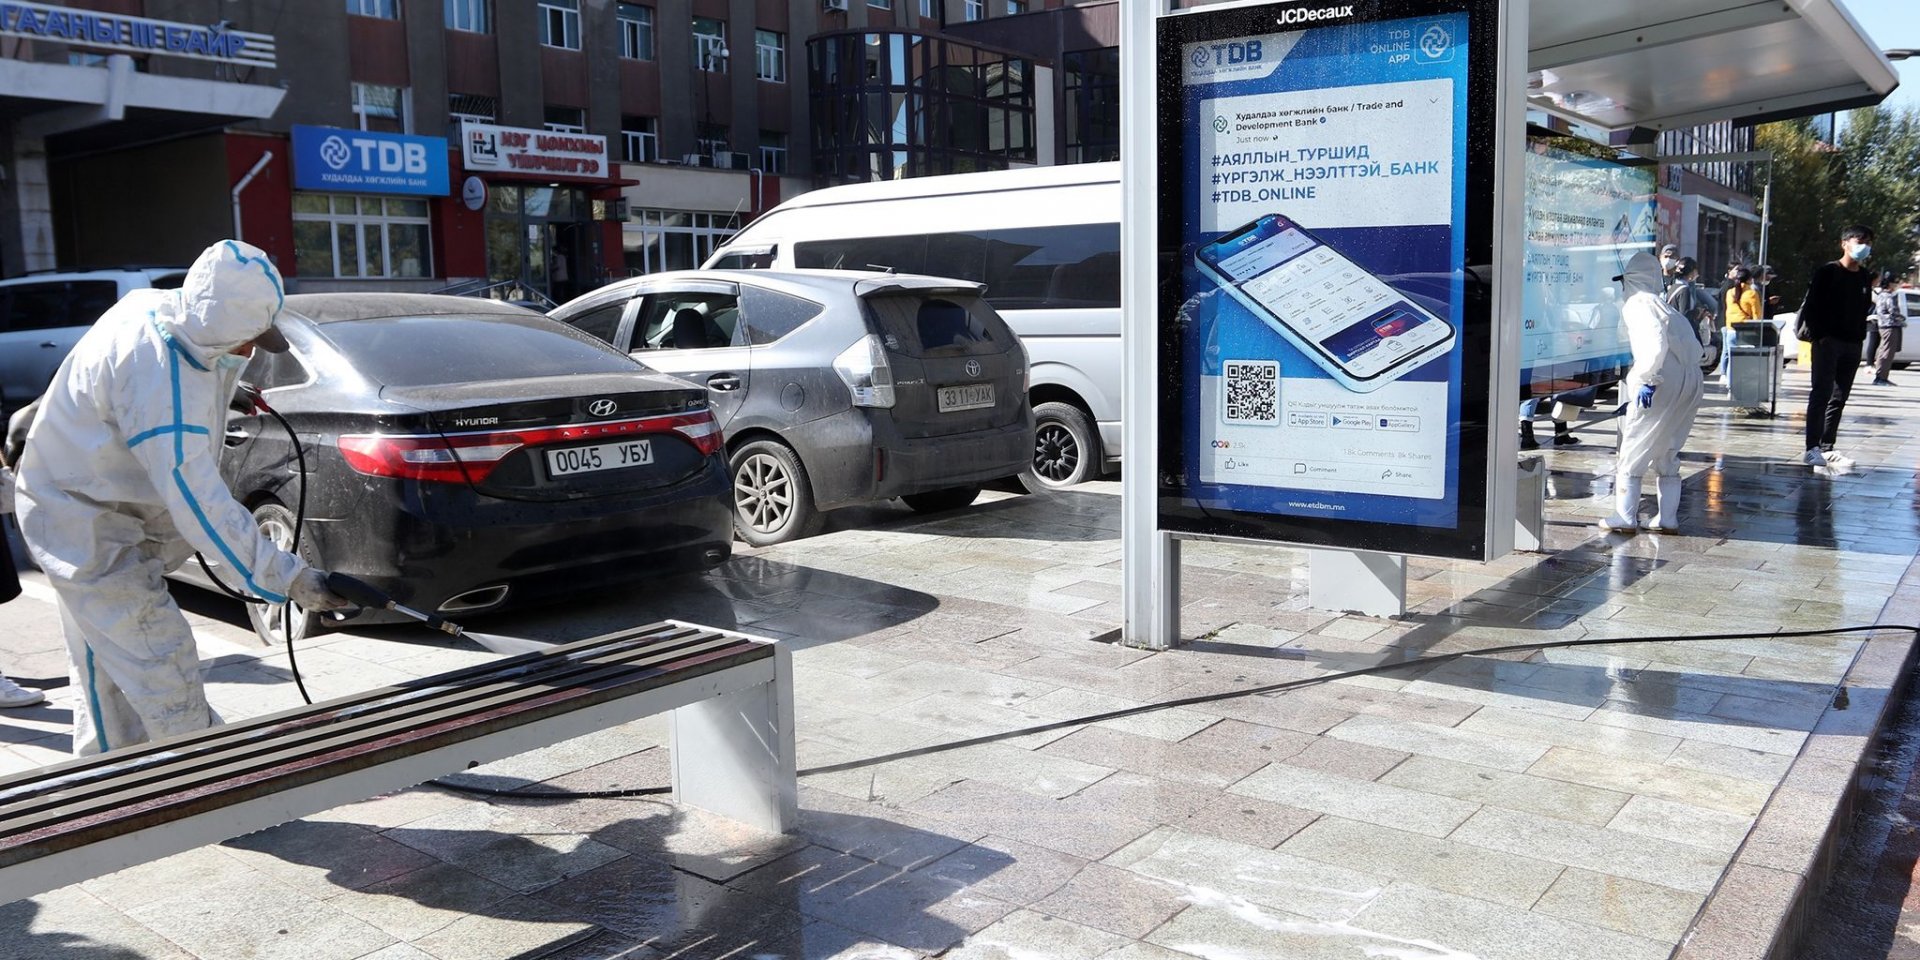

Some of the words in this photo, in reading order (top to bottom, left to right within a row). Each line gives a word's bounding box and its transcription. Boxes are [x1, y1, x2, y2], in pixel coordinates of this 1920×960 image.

[1277, 5, 1353, 25] JCDecaux
[1389, 30, 1411, 40] TDB
[1211, 40, 1263, 65] TDB
[1370, 41, 1411, 53] ONLINE
[1388, 54, 1411, 64] APP
[1236, 111, 1277, 122] Худалдаа
[1279, 107, 1324, 117] хөгжлийн
[1326, 105, 1349, 114] банк
[1350, 103, 1355, 113] /
[1357, 102, 1384, 112] Trade
[1385, 100, 1404, 110] and
[1236, 120, 1293, 132] Development
[1295, 117, 1318, 127] Bank
[1236, 136, 1252, 144] Just
[352, 138, 427, 174] TDB
[1211, 145, 1370, 168] #АЯЛЛЫН_ТУРШИД
[1211, 160, 1439, 185] #ҮРГЭЛЖ_НЭЭЛТТЭЙ_БАНК
[321, 173, 363, 183] ХУДАЛДАА
[365, 175, 407, 186] ХӨГЖЛИЙН
[408, 178, 428, 187] БАНК
[1211, 186, 1316, 204] #TDB_ONLINE
[975, 386, 992, 402] УАК
[456, 416, 499, 427] HYUNDAI
[1298, 418, 1309, 426] App
[1343, 418, 1361, 427] Google
[556, 446, 602, 472] 0045
[618, 443, 650, 465] УБУ
[1357, 449, 1395, 457] Comments
[1408, 452, 1432, 460] Shares
[1288, 501, 1346, 511] www.etdbm.mn
